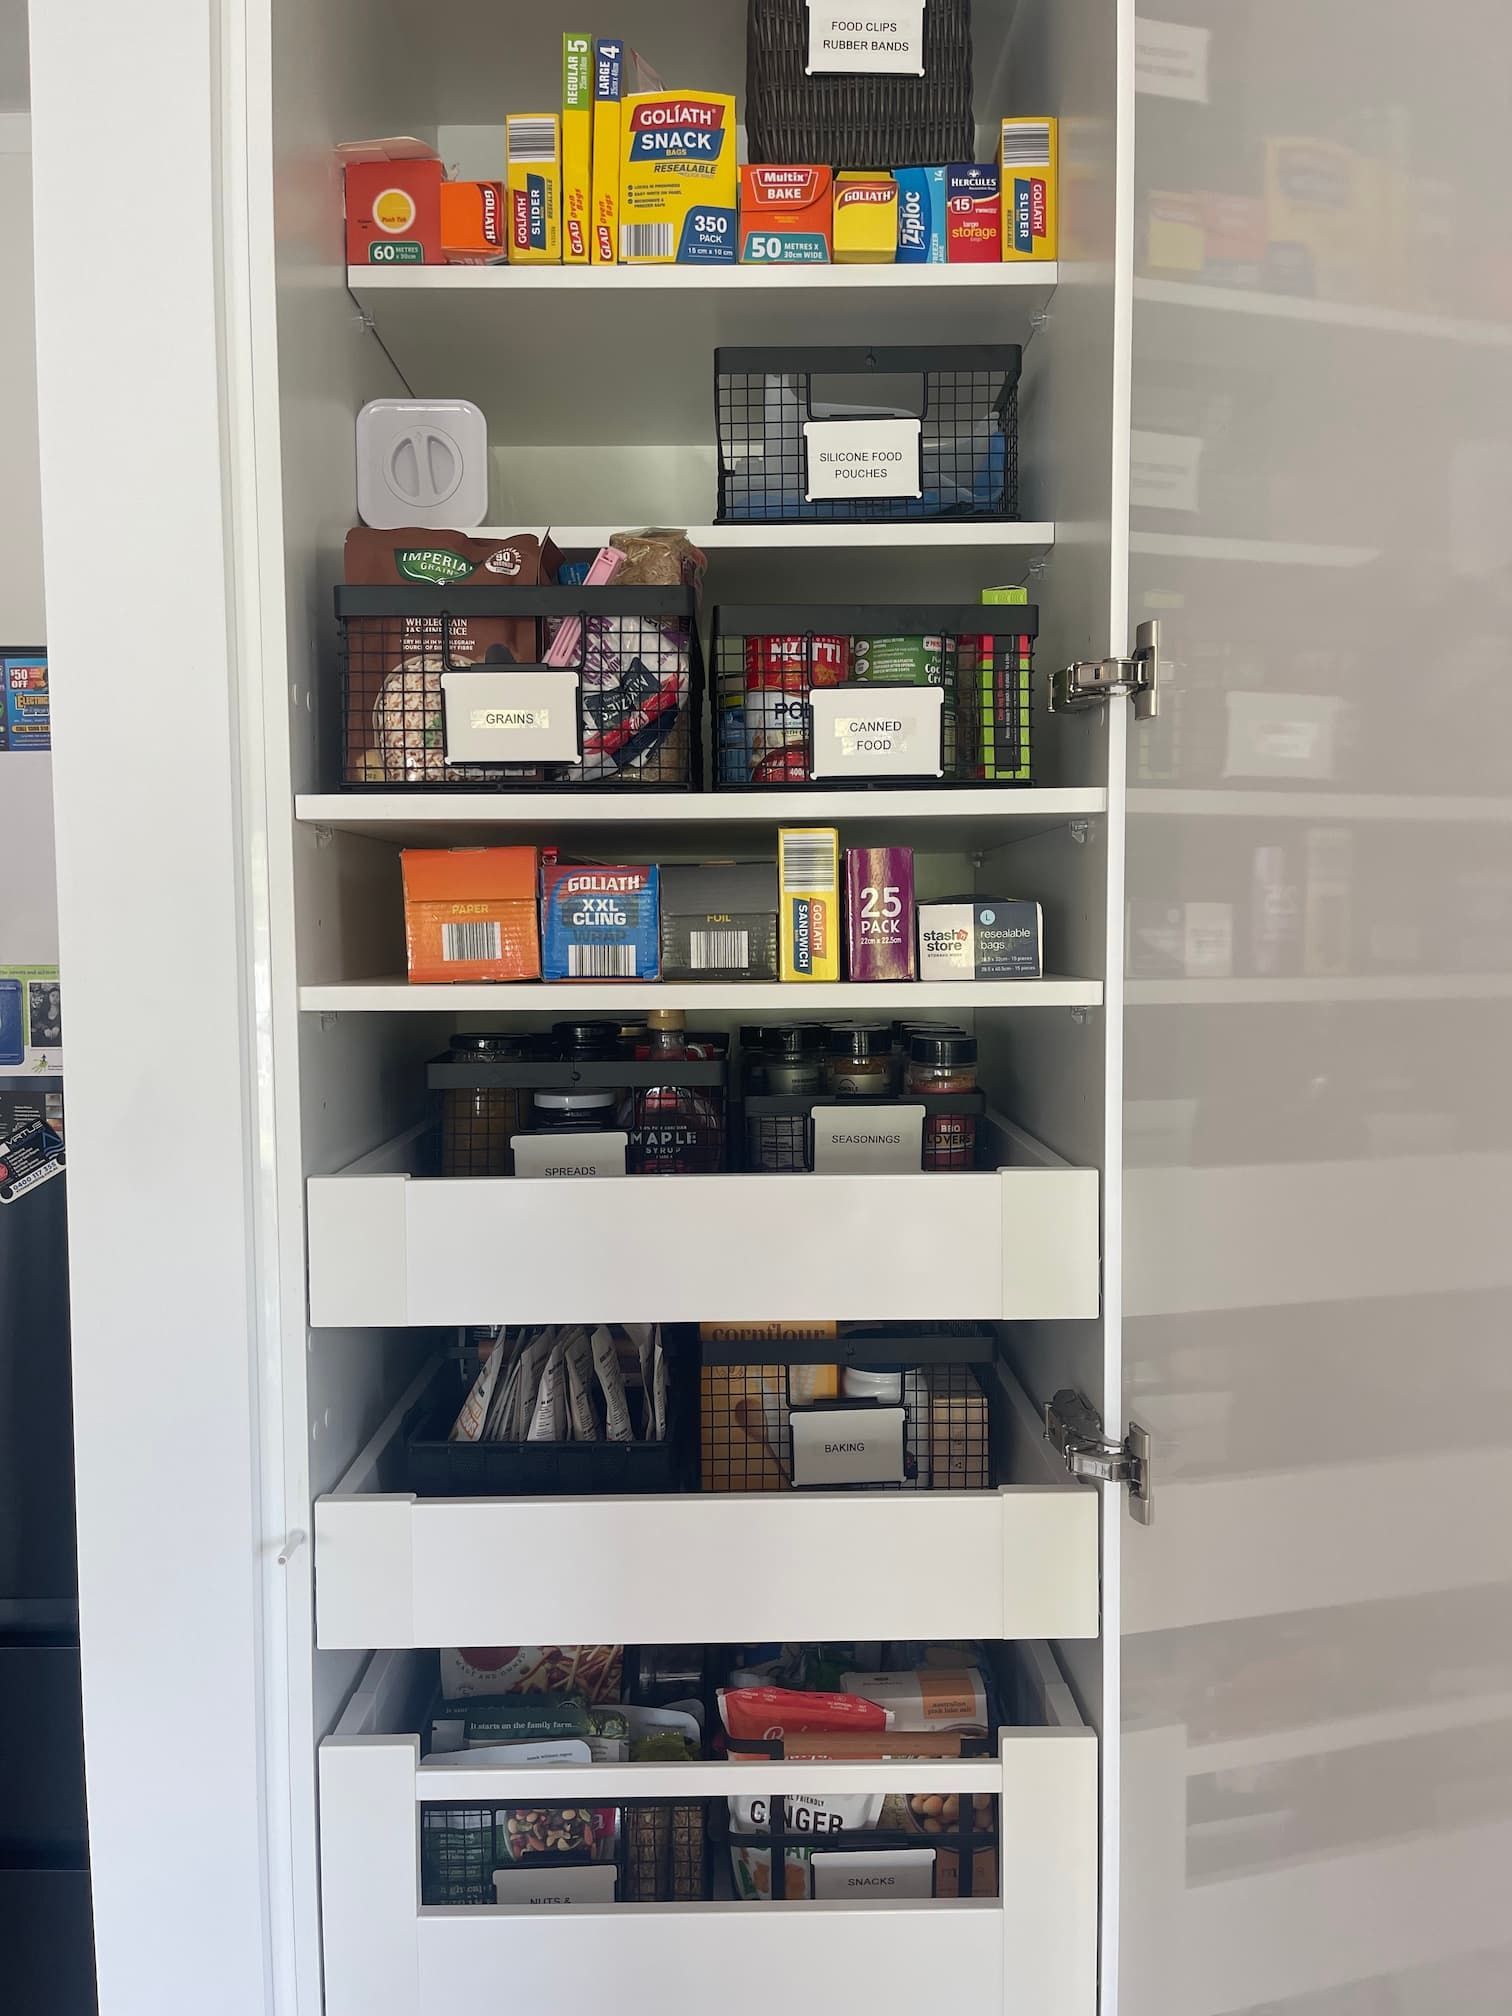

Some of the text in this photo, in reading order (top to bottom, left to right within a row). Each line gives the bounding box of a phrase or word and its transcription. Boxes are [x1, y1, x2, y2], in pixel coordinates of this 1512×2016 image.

[831, 21, 897, 33] FOOD CLIPS
[568, 40, 588, 53] 5
[823, 39, 909, 52] RUBBER BANDS
[600, 46, 620, 59] 4
[568, 56, 578, 104] REGULAR
[599, 61, 610, 96] LARGE
[641, 131, 711, 150] SNACK
[654, 164, 716, 175] RESEALABLE
[764, 172, 804, 183] Multix
[934, 170, 944, 182] 14
[951, 178, 997, 187] HERCULES
[767, 189, 801, 199] BAKE
[844, 191, 891, 202] GOLIATH
[953, 198, 970, 211] 15
[484, 190, 496, 240] GOLIATH
[531, 189, 540, 235] SLIDER
[902, 191, 925, 245] Ziploc
[1020, 192, 1029, 238] SLIDER
[695, 215, 727, 233] 350
[570, 222, 583, 254] GLAD
[699, 234, 722, 243] PACK
[951, 227, 997, 240] storage
[599, 227, 612, 259] GLAD
[752, 237, 782, 258] 50
[374, 245, 395, 260] 60
[784, 251, 823, 259] 30cm WIDE
[819, 451, 903, 463] SILICONE FOOD
[835, 468, 888, 479] POUCHES
[495, 551, 511, 562] 90
[10, 669, 28, 681] $50
[11, 680, 28, 688] OFF
[486, 713, 534, 725] GRAINS
[849, 720, 902, 733] CANNED
[856, 740, 892, 751] FOOD
[568, 875, 640, 892] GOLIATH
[582, 899, 619, 912] XXL
[860, 886, 902, 918] 25
[452, 904, 489, 914] PAPER
[573, 912, 627, 925] CLING
[985, 913, 991, 921] L
[861, 920, 900, 934] PACK
[980, 927, 1031, 938] resealable
[799, 904, 809, 968] SANDWICH
[881, 936, 902, 944] 22.5cm
[923, 928, 959, 941] stash
[927, 940, 962, 951] store
[980, 940, 1006, 951] bags
[631, 1131, 697, 1145] MAPLE
[831, 1135, 901, 1144] SEASONINGS
[646, 1146, 681, 1154] SYRUP
[545, 1166, 596, 1176] SPREADS
[712, 1323, 825, 1340] cornflour
[824, 1441, 865, 1453] BAKING
[527, 1721, 551, 1731] family
[795, 1794, 825, 1807] FRIENDLY
[848, 1877, 895, 1887] SNACKS
